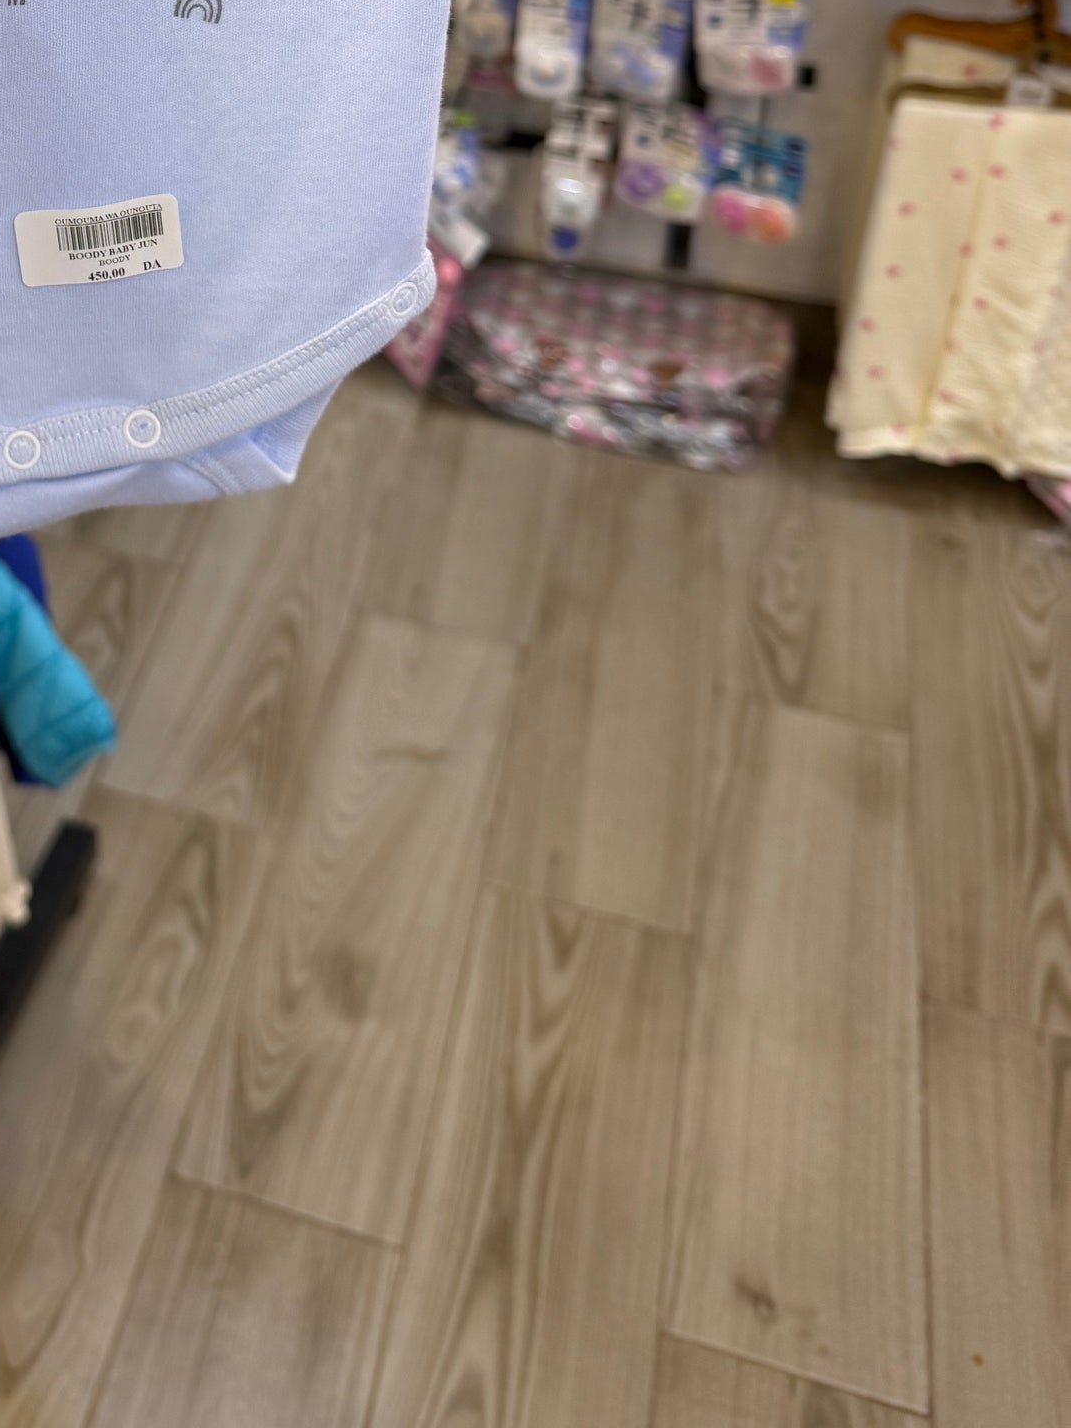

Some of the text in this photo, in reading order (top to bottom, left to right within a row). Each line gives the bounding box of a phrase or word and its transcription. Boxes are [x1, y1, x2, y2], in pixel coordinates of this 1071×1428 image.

[55, 215, 104, 225] OUMOUMA
[105, 212, 119, 220] WA
[69, 238, 158, 261] BOODY BABY JUN
[99, 254, 131, 267] BOODY
[143, 259, 162, 271] DA
